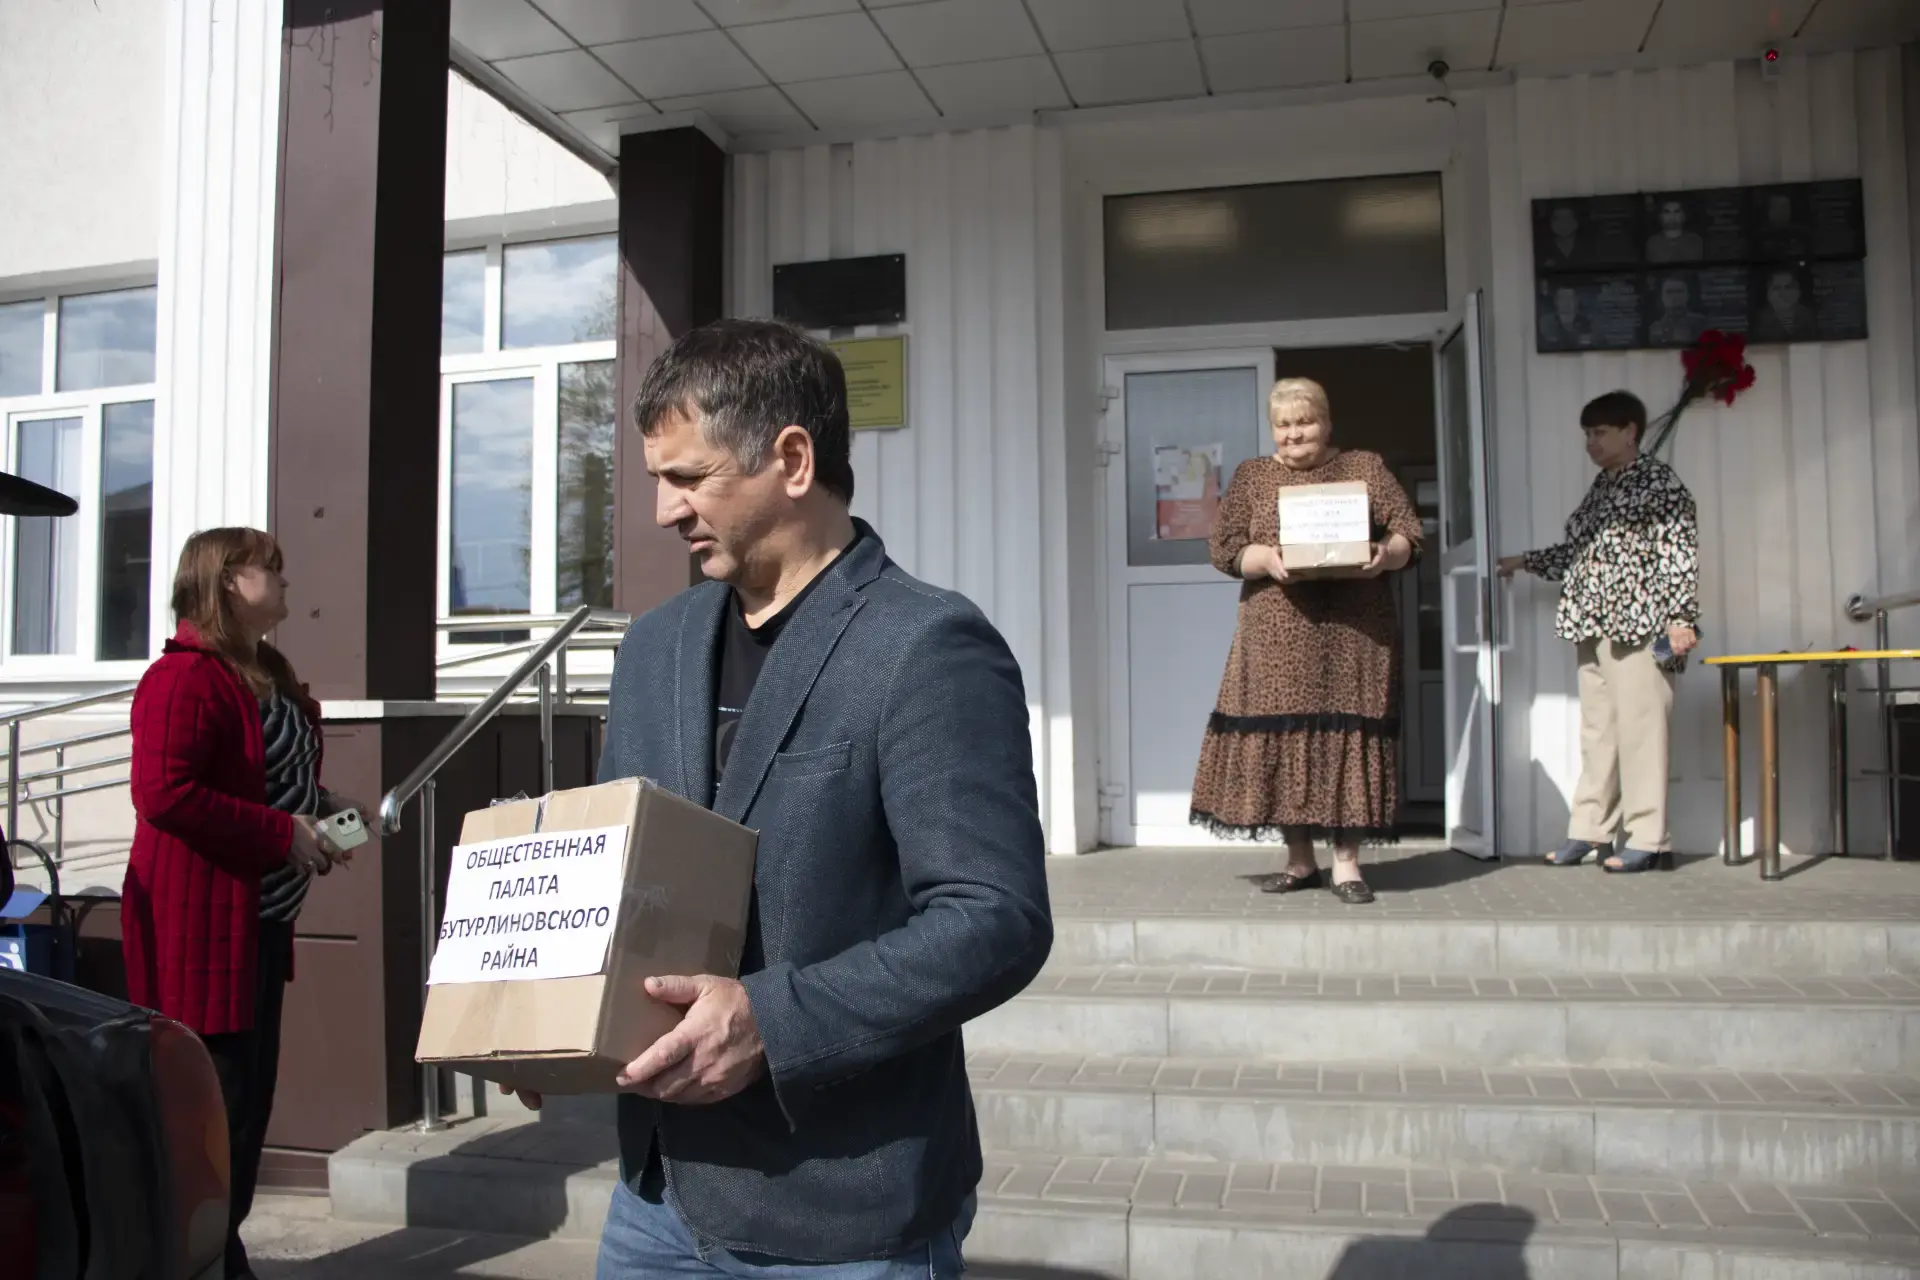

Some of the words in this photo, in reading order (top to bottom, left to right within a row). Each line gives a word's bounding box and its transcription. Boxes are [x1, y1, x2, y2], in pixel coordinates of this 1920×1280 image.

[466, 834, 606, 870] ОБЩЕСТВЕННАЯ
[488, 873, 559, 900] ПАЛАТА
[440, 906, 610, 940] БУТУРЛИНОВСКОГО
[480, 943, 538, 971] РАЙНА
